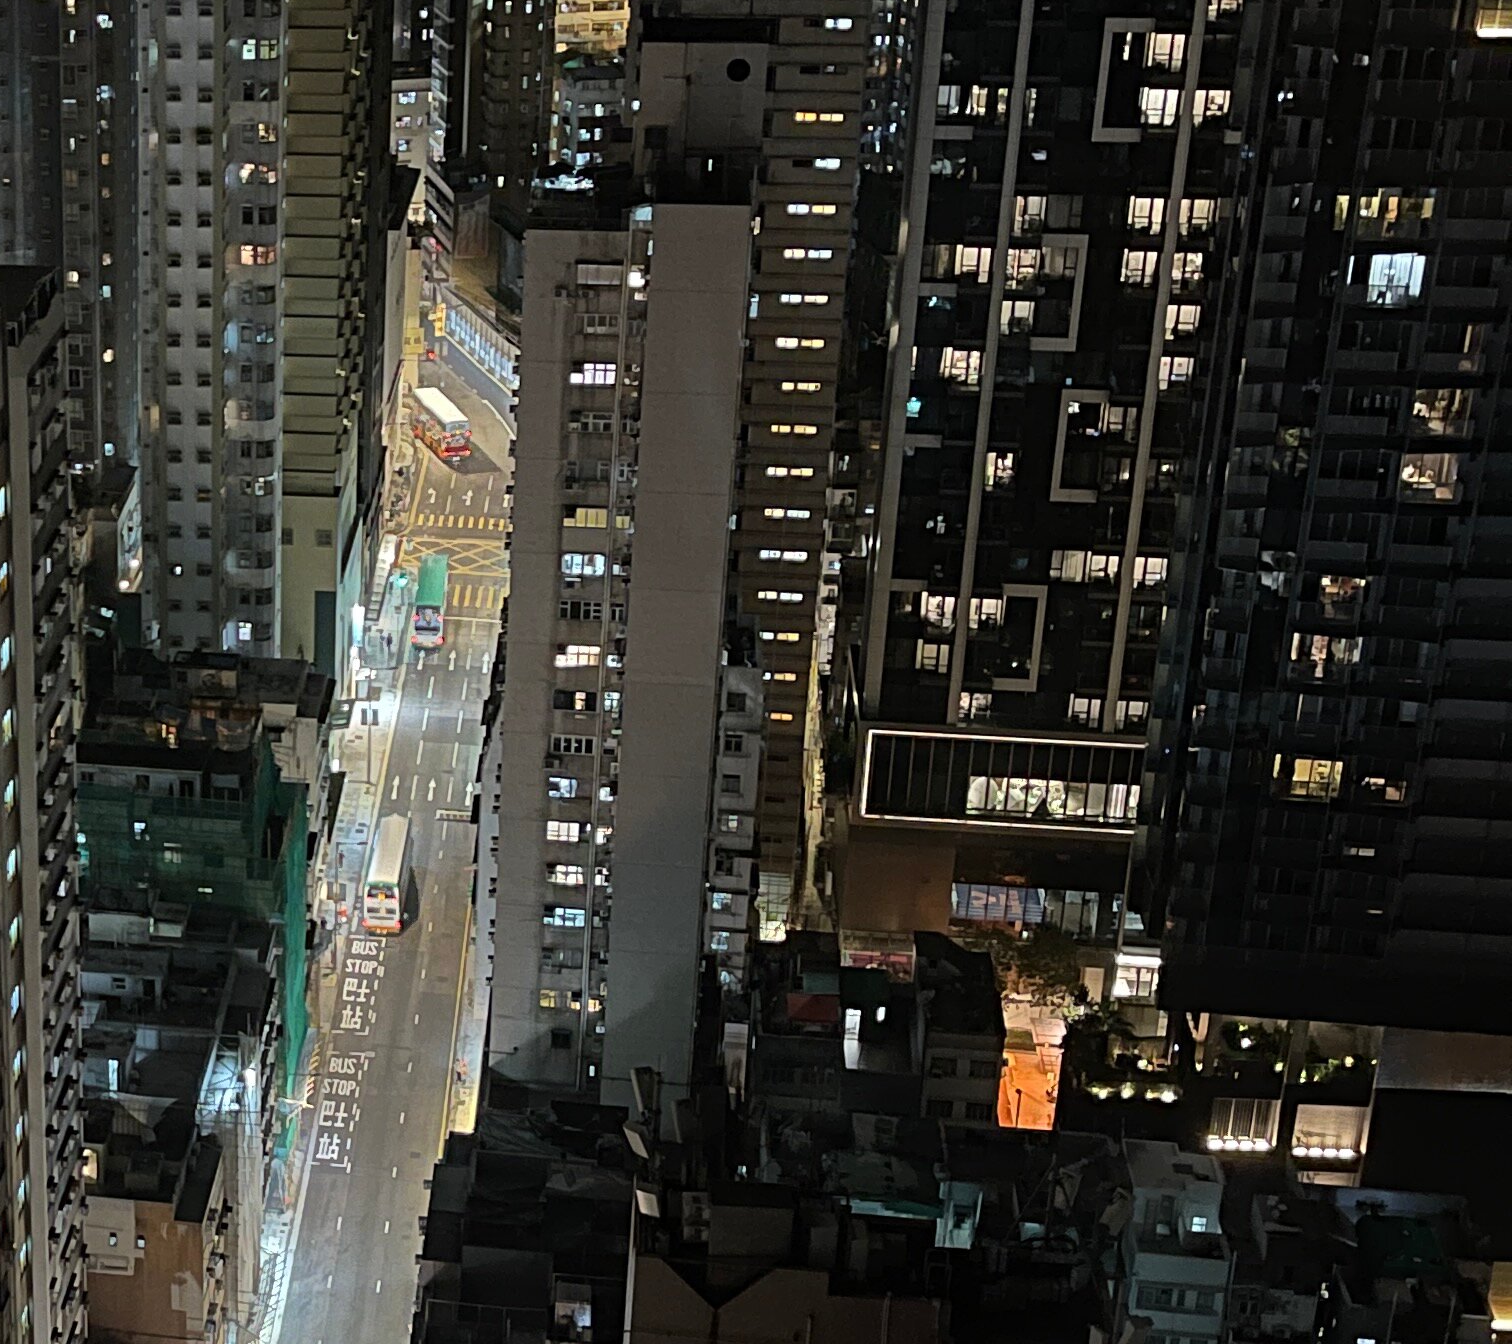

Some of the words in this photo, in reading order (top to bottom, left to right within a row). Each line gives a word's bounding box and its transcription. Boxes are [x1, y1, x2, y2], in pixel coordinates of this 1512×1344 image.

[351, 940, 378, 955] BUS
[345, 958, 378, 974] STOP
[342, 977, 370, 1002] 巴士
[340, 1004, 363, 1029] 站
[329, 1057, 357, 1074] BUS
[322, 1078, 356, 1096] STOP
[319, 1100, 348, 1127] 巴士
[316, 1132, 341, 1160] 站
